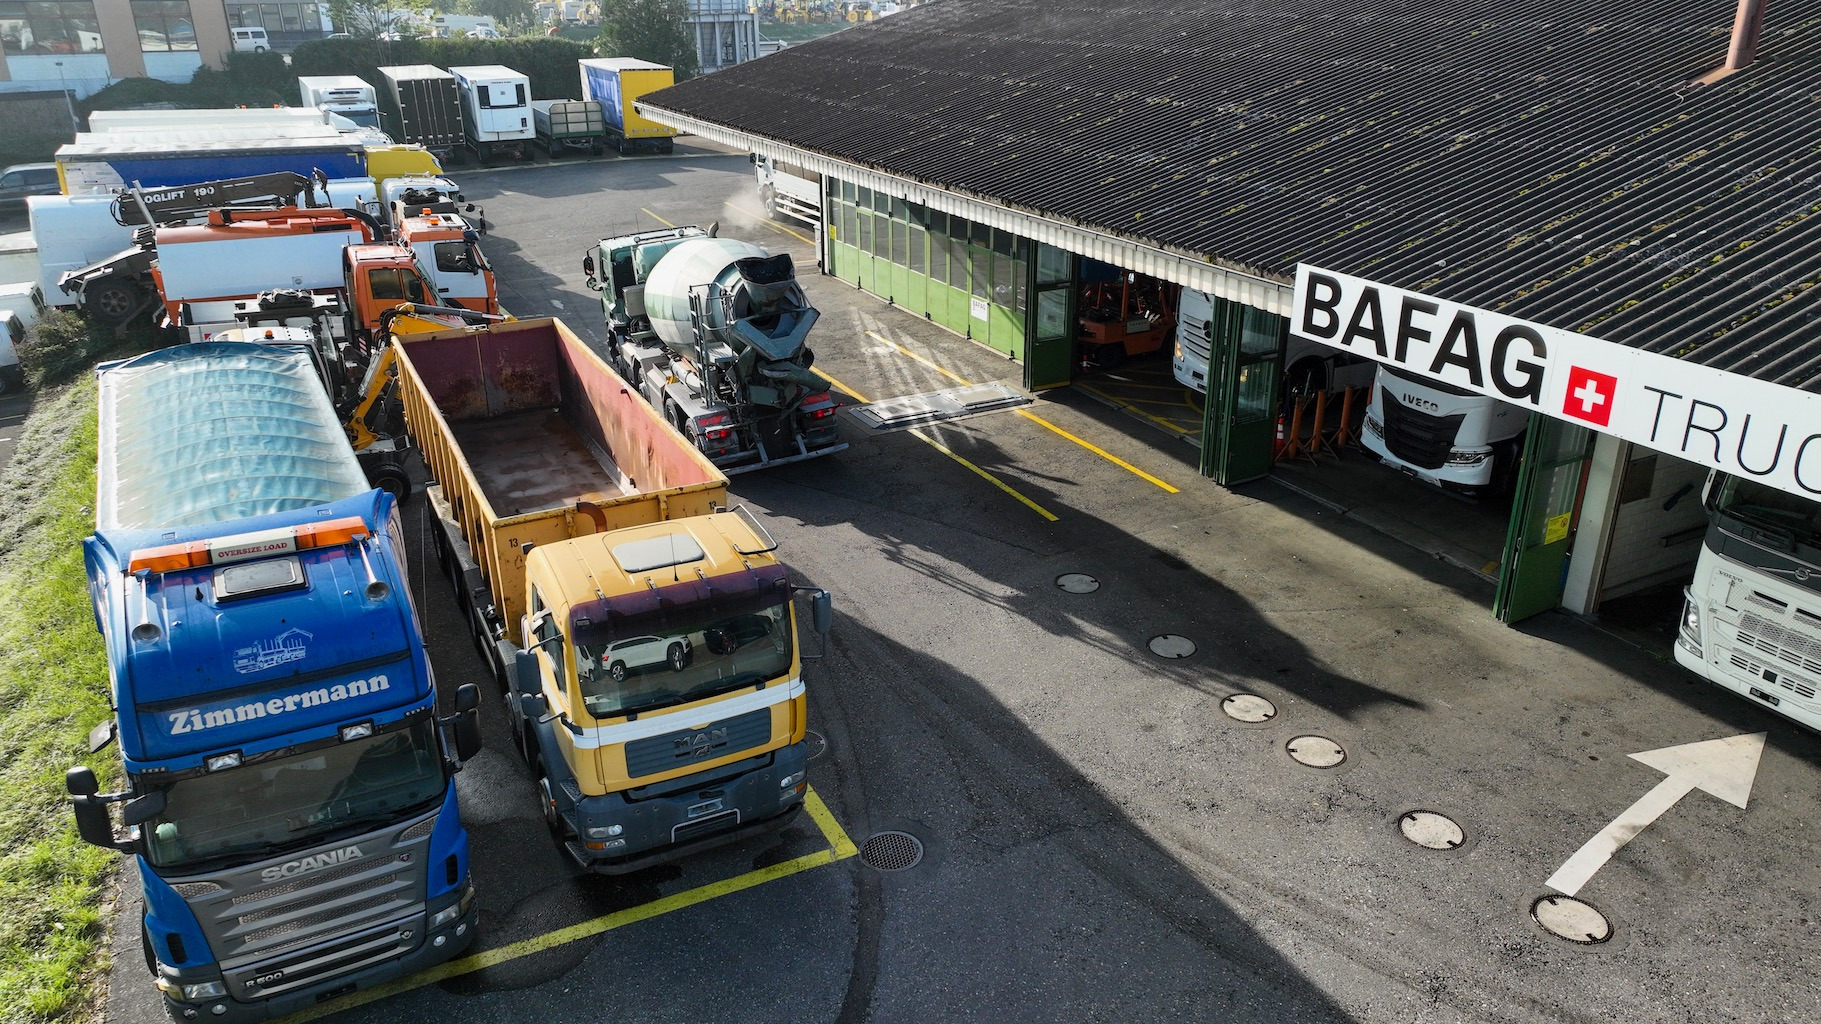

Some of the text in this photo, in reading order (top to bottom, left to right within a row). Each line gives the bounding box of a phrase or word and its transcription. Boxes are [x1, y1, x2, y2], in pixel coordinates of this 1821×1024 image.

[139, 187, 214, 204] OGLIFT 190
[1302, 270, 1547, 405] BAFAG
[1403, 393, 1438, 412] IVECO
[218, 542, 287, 558] OVERSIZE LOAD
[509, 538, 518, 548] 13
[1719, 570, 1743, 582] VOLVO
[169, 674, 390, 735] Zimmermann
[674, 727, 728, 749] MAN
[261, 845, 363, 883] SCANIA
